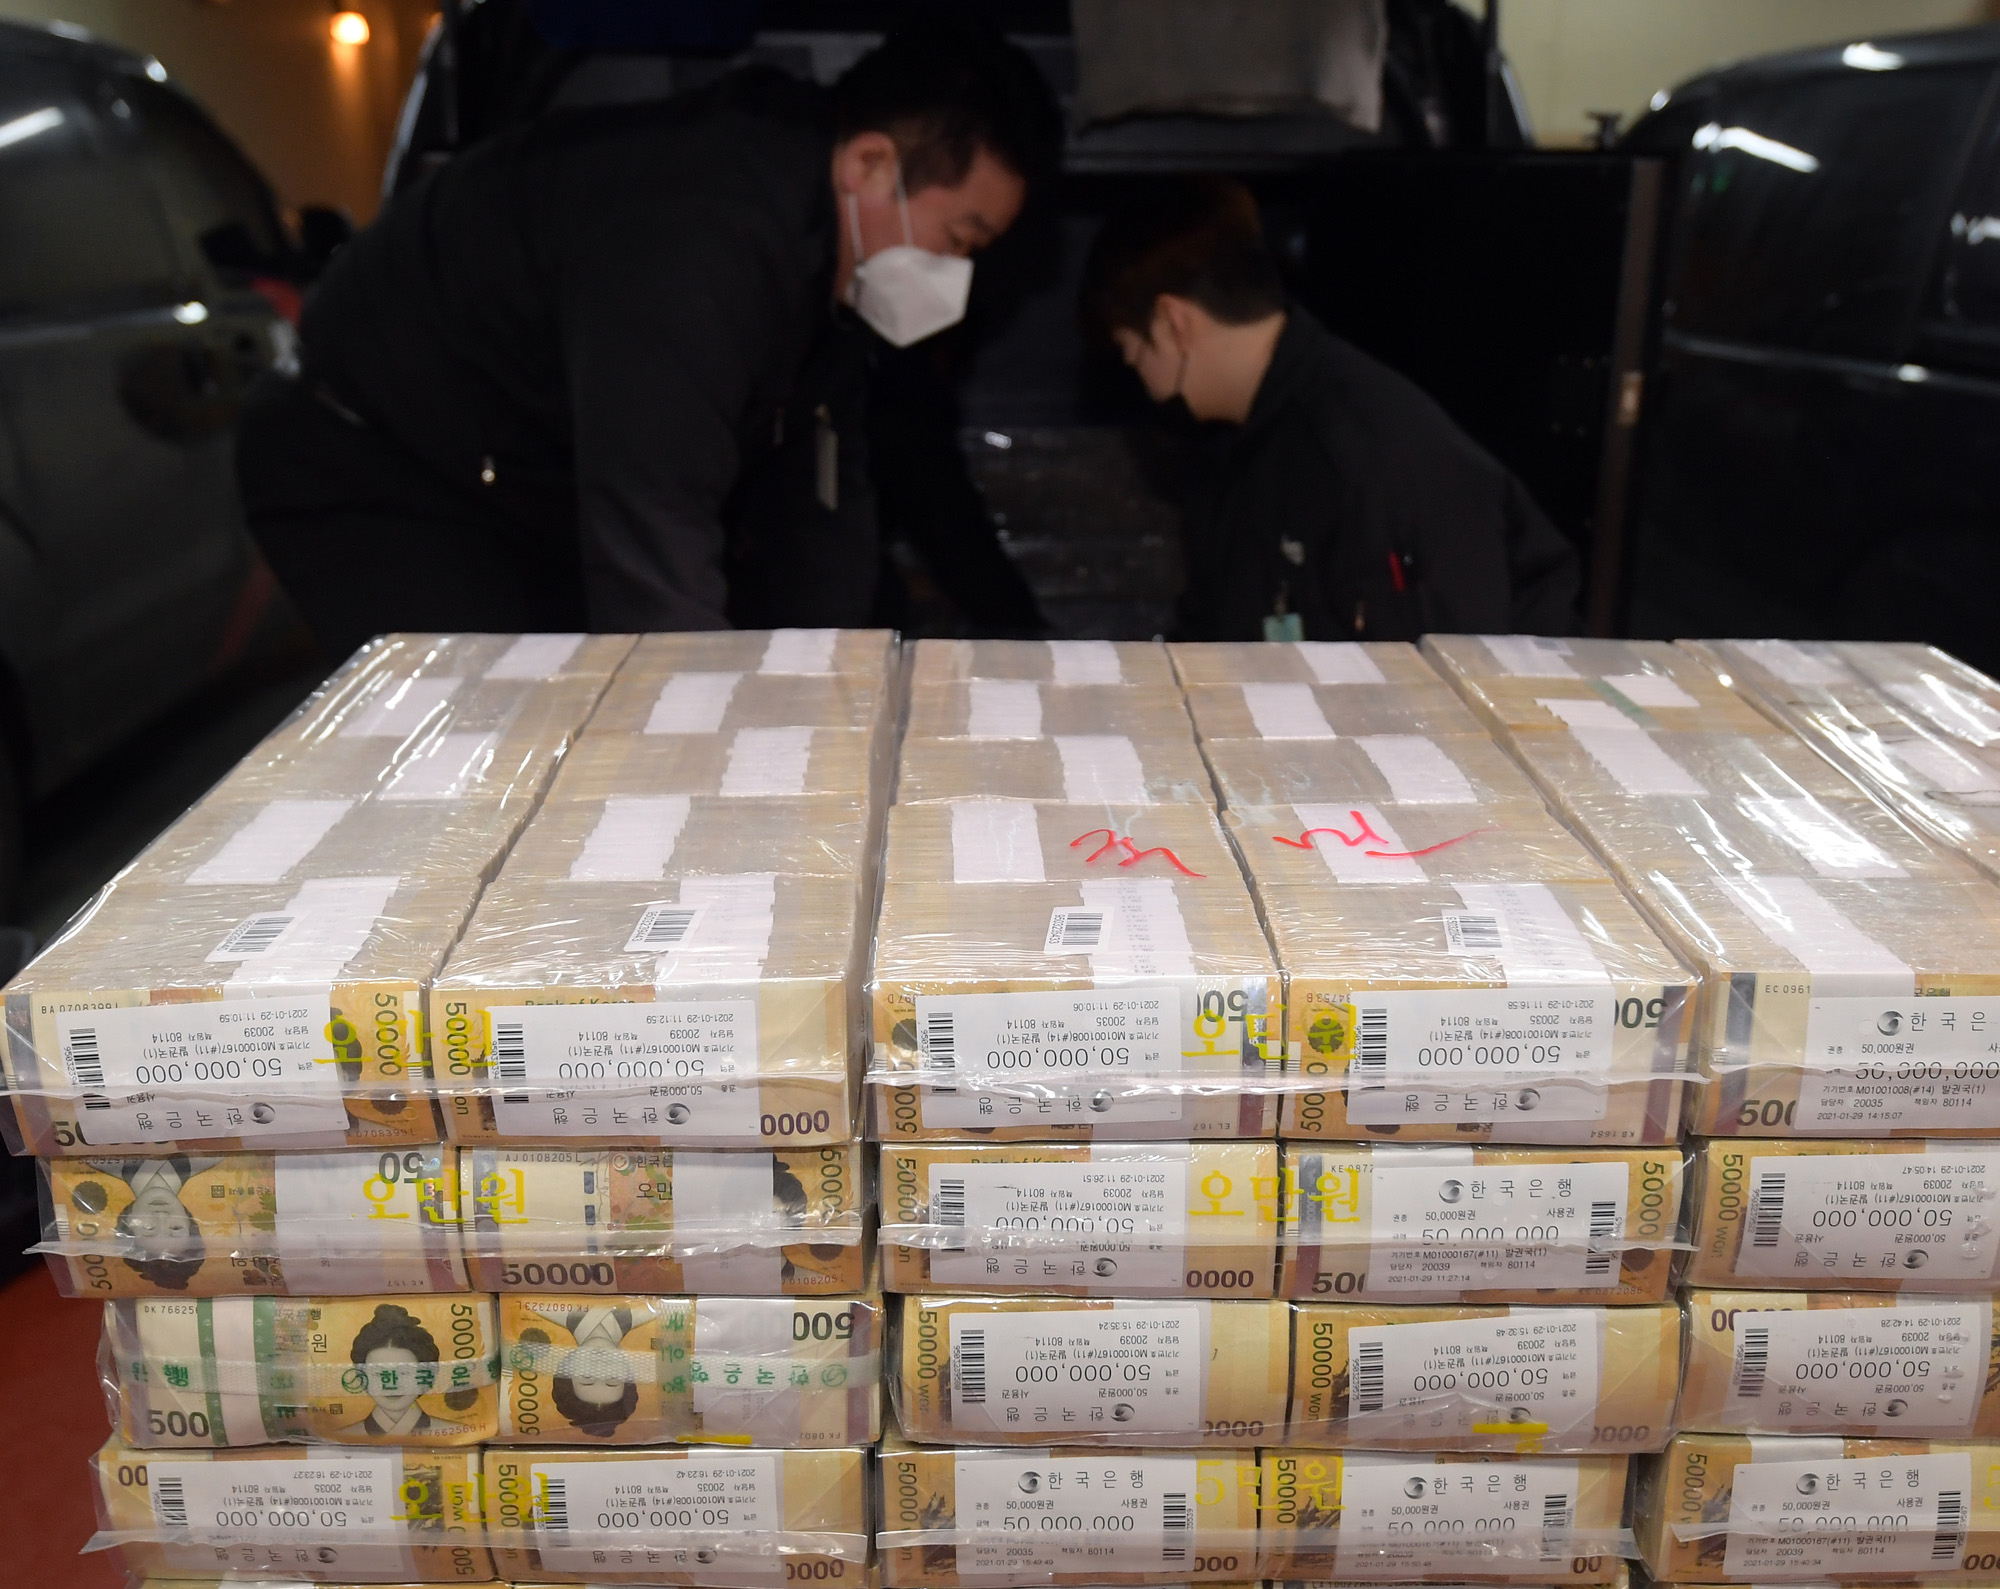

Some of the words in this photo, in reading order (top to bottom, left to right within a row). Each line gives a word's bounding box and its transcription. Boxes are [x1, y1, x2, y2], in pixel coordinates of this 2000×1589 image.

[1765, 985, 1778, 994] EC
[1783, 985, 1810, 994] 0961
[1073, 1003, 1108, 1012] 11:10:06
[1112, 1001, 1159, 1011] 2021-01-29
[1508, 1001, 1542, 1009] 11:16:58
[1548, 1000, 1594, 1009] 2021-01-29
[42, 1006, 54, 1014] BA
[219, 1013, 255, 1024] 11:10:59
[260, 1009, 308, 1022] 2021-01-29
[646, 1015, 681, 1024] 11:12:59
[687, 1014, 733, 1023] 2021-01-29
[1530, 1015, 1559, 1025] 20035
[1007, 1019, 1036, 1029] 80114
[1096, 1016, 1125, 1026] 20035
[1441, 1016, 1470, 1026] 80114
[244, 1026, 274, 1037] 20039
[374, 992, 402, 1078] 50000
[579, 1031, 608, 1042] 80114
[670, 1029, 699, 1039] 20039
[152, 1032, 182, 1043] 80114
[446, 1001, 470, 1076] 50000
[194, 1040, 277, 1059] M01000167(#11)
[1861, 1043, 1914, 1054] 50,000원권
[987, 1046, 1129, 1069] 50,000,000
[1419, 1044, 1560, 1066] 50,000,000
[136, 1058, 281, 1086] 50,000,000
[559, 1058, 704, 1079] 50,000,000
[1853, 1099, 1883, 1109] 20035
[1943, 1098, 1971, 1107] 80114
[1817, 1112, 1863, 1120] 2021-01-29
[506, 1153, 520, 1163] AJ
[518, 1153, 575, 1164] 0108205
[1331, 1164, 1344, 1173] KE
[1902, 1166, 1936, 1174] 14:05:47
[1941, 1165, 1985, 1174] 2021-01-29
[1083, 1175, 1115, 1183] 11:26:51
[1120, 1174, 1165, 1183] 2021-01-29
[1718, 1154, 1744, 1222] 50000
[1837, 1181, 1865, 1190] 80114
[1923, 1180, 1952, 1189] 20039
[1013, 1187, 1044, 1198] 80114
[1103, 1188, 1131, 1199] 20039
[1638, 1161, 1665, 1236] 50000
[1425, 1210, 1476, 1221] 50,000원권
[1547, 1207, 1574, 1218] 사용권
[1813, 1208, 1952, 1227] 50,000,000
[1895, 1234, 1946, 1243] 50,000원권
[1422, 1262, 1451, 1271] 20039
[1508, 1260, 1535, 1269] 80114
[501, 1262, 615, 1286] 50000
[1388, 1275, 1432, 1284] 2021-01-29
[524, 1301, 571, 1312] 0807323
[574, 1304, 589, 1312] FK
[1099, 1322, 1131, 1330] 15:35:24
[1135, 1320, 1179, 1331] 2021-01-29
[1881, 1319, 1913, 1328] 14:42:28
[1918, 1317, 1961, 1327] 2021-01-29
[1496, 1327, 1528, 1337] 15:32:48
[1533, 1324, 1576, 1334] 2021-01-29
[1036, 1337, 1062, 1347] 80114
[1120, 1335, 1147, 1345] 20039
[1819, 1334, 1845, 1344] 80114
[1902, 1332, 1929, 1342] 20039
[311, 1334, 327, 1353] 원
[917, 1311, 938, 1379] 50000
[1518, 1340, 1544, 1350] 20039
[1311, 1322, 1333, 1388] 50000
[1434, 1345, 1461, 1356] 80114
[1016, 1363, 1150, 1382] 50,000,000
[1796, 1359, 1930, 1379] 50,000,000
[1414, 1368, 1548, 1391] 50,000,000
[1002, 1389, 1029, 1399] 사용권
[1099, 1387, 1147, 1398] 50,000원권
[1875, 1384, 1924, 1394] 50,000원권
[1495, 1392, 1544, 1402] 50,000원권
[330, 1471, 372, 1479] 2021-01-29
[713, 1469, 755, 1478] 2021-01-29
[697, 1483, 724, 1492] 20035
[1682, 1453, 1708, 1513] 50000
[232, 1485, 259, 1493] 80114
[314, 1484, 341, 1493] 20035
[615, 1485, 641, 1494] 80114
[1006, 1500, 1054, 1510] 50,000원권
[1121, 1498, 1147, 1508] 사용권
[1391, 1505, 1438, 1516] 50,000원권
[1504, 1500, 1529, 1510] 사용권
[1782, 1501, 1830, 1511] 50,000원권
[1897, 1497, 1923, 1508] 사용권
[216, 1507, 346, 1528] 50,000,000
[598, 1509, 733, 1530] 50,000,000
[1007, 1548, 1033, 1556] 20035
[1088, 1548, 1114, 1556] 80114
[1776, 1548, 1805, 1556] 20039
[1858, 1547, 1884, 1555] 80114
